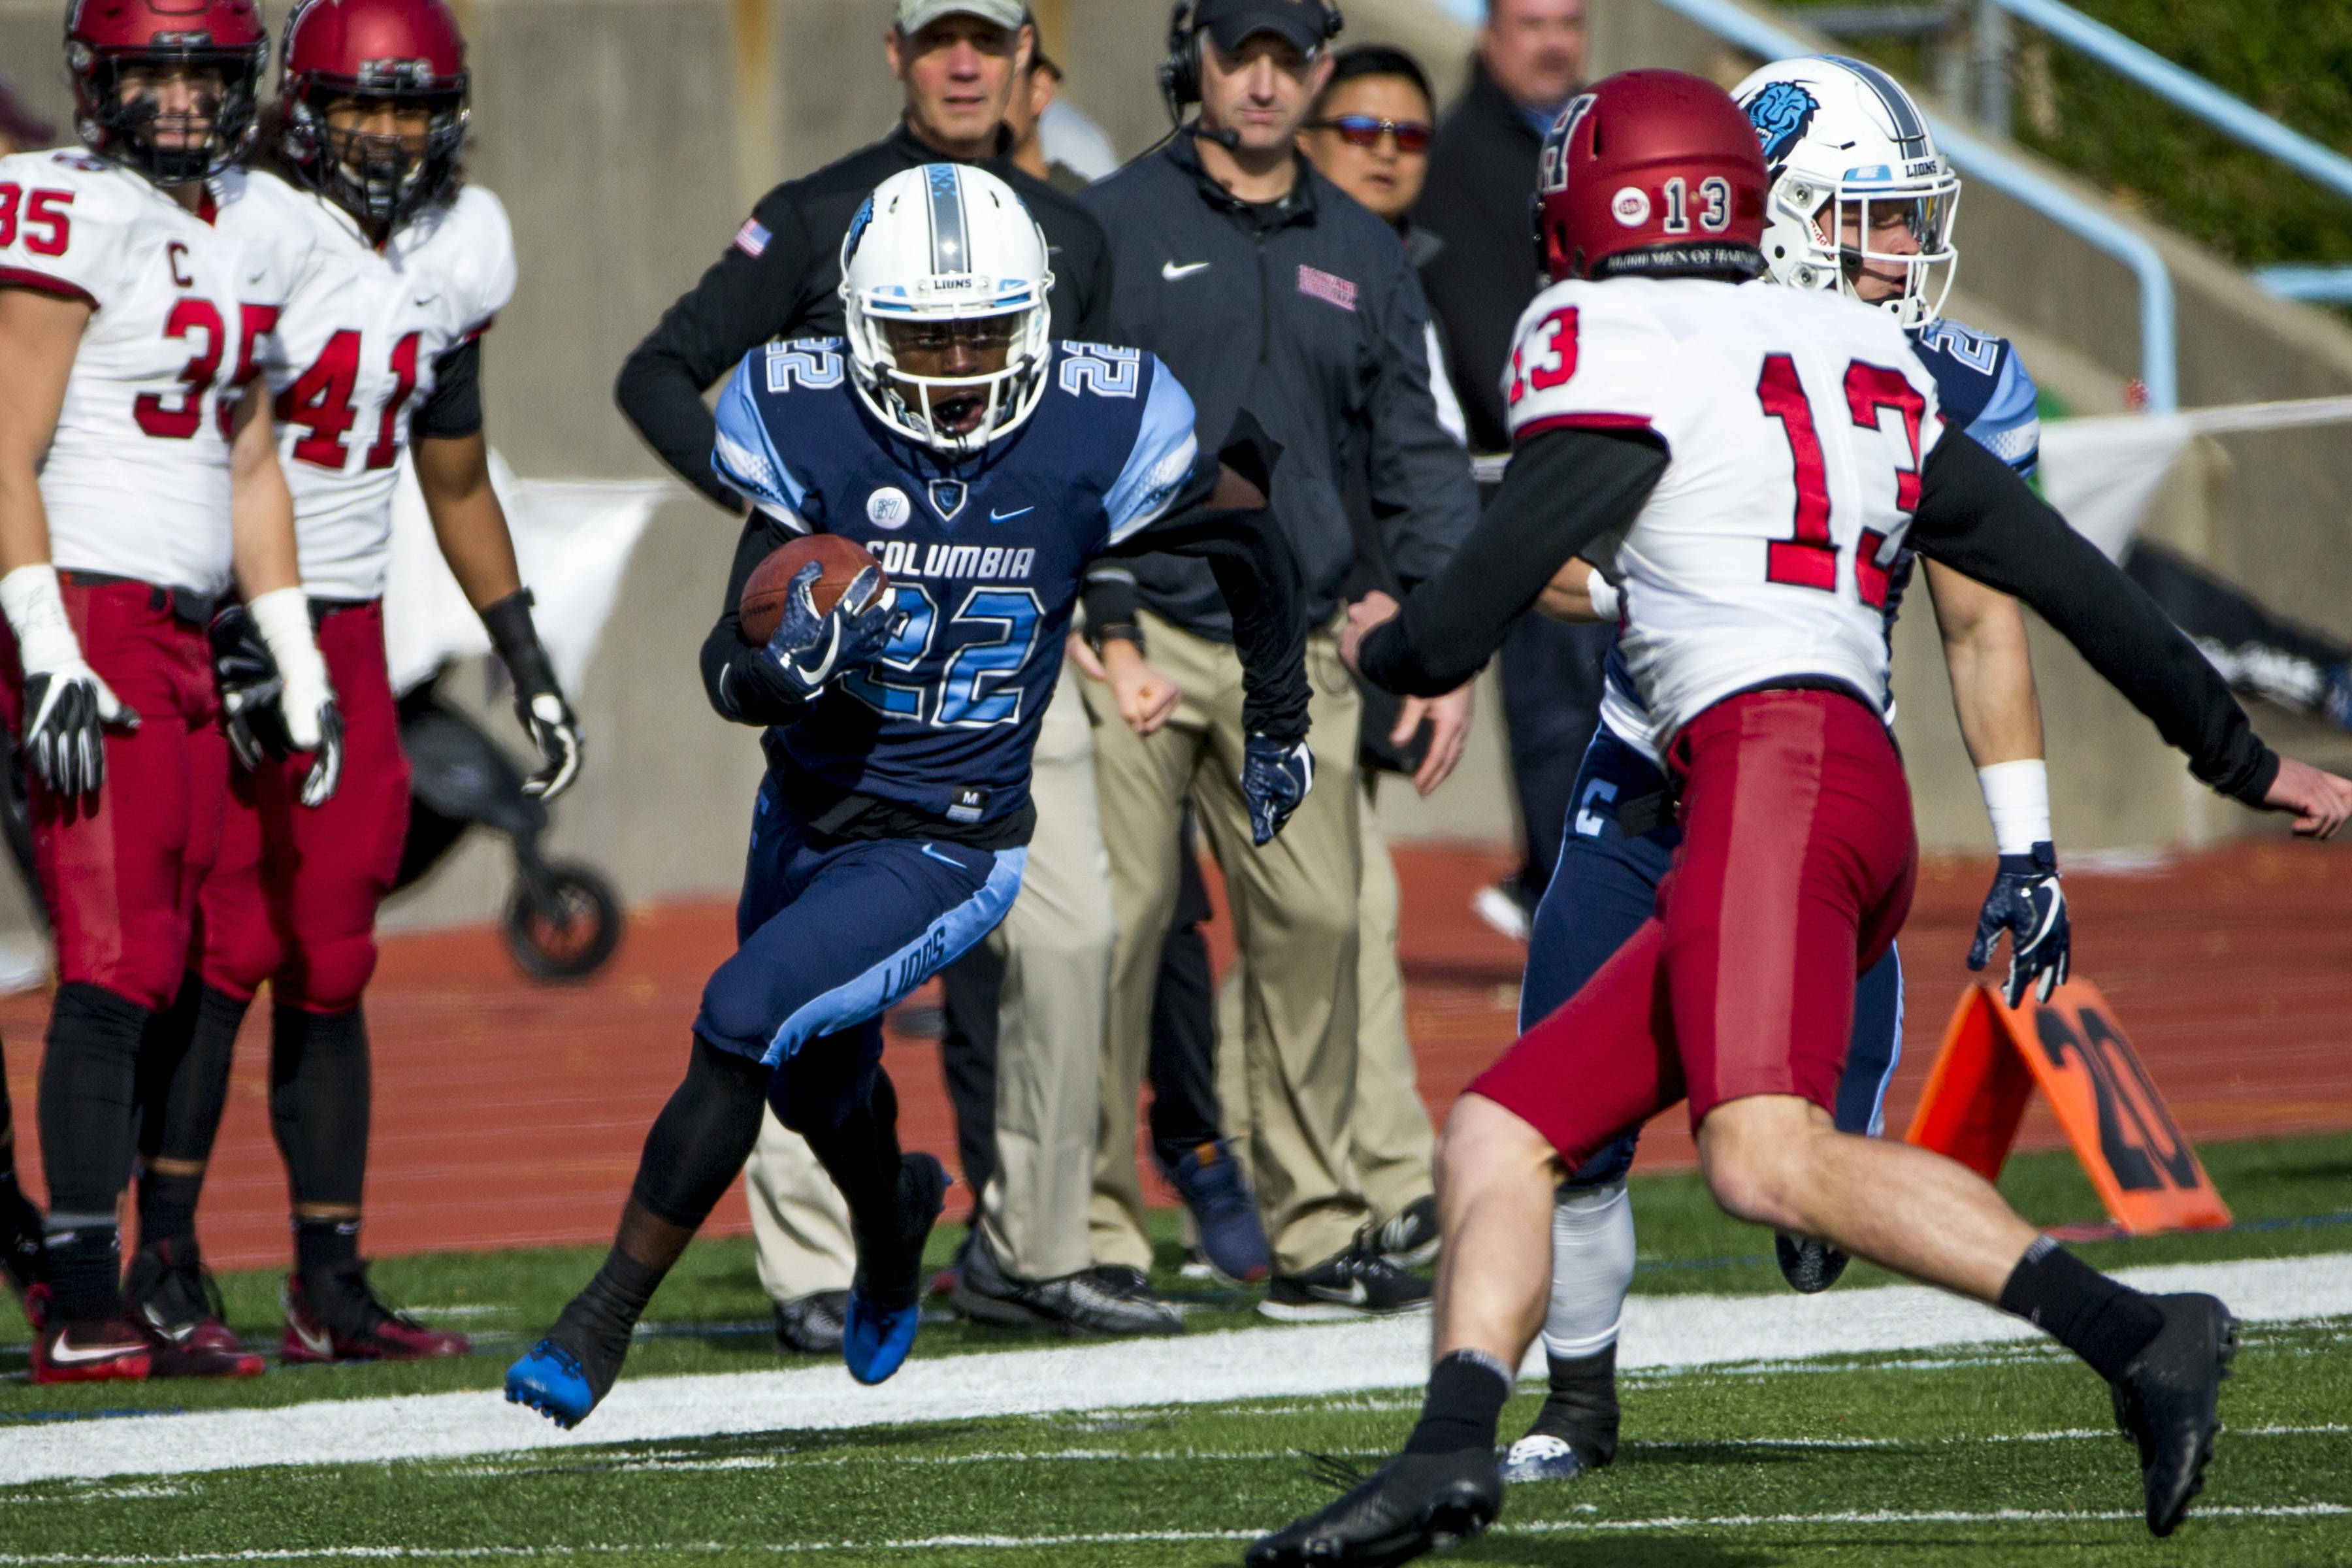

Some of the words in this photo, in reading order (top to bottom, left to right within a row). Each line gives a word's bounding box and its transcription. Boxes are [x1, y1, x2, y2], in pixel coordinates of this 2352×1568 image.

[1905, 161, 1937, 178] LIONS
[1663, 176, 1731, 233] 13
[167, 240, 194, 287] C
[934, 278, 972, 289] LIONS
[1919, 318, 1999, 376] 2
[274, 329, 421, 470] 41
[1756, 352, 1926, 610] 13
[842, 581, 1047, 728] 22
[962, 791, 979, 805] M
[2035, 1007, 2199, 1190] 20
